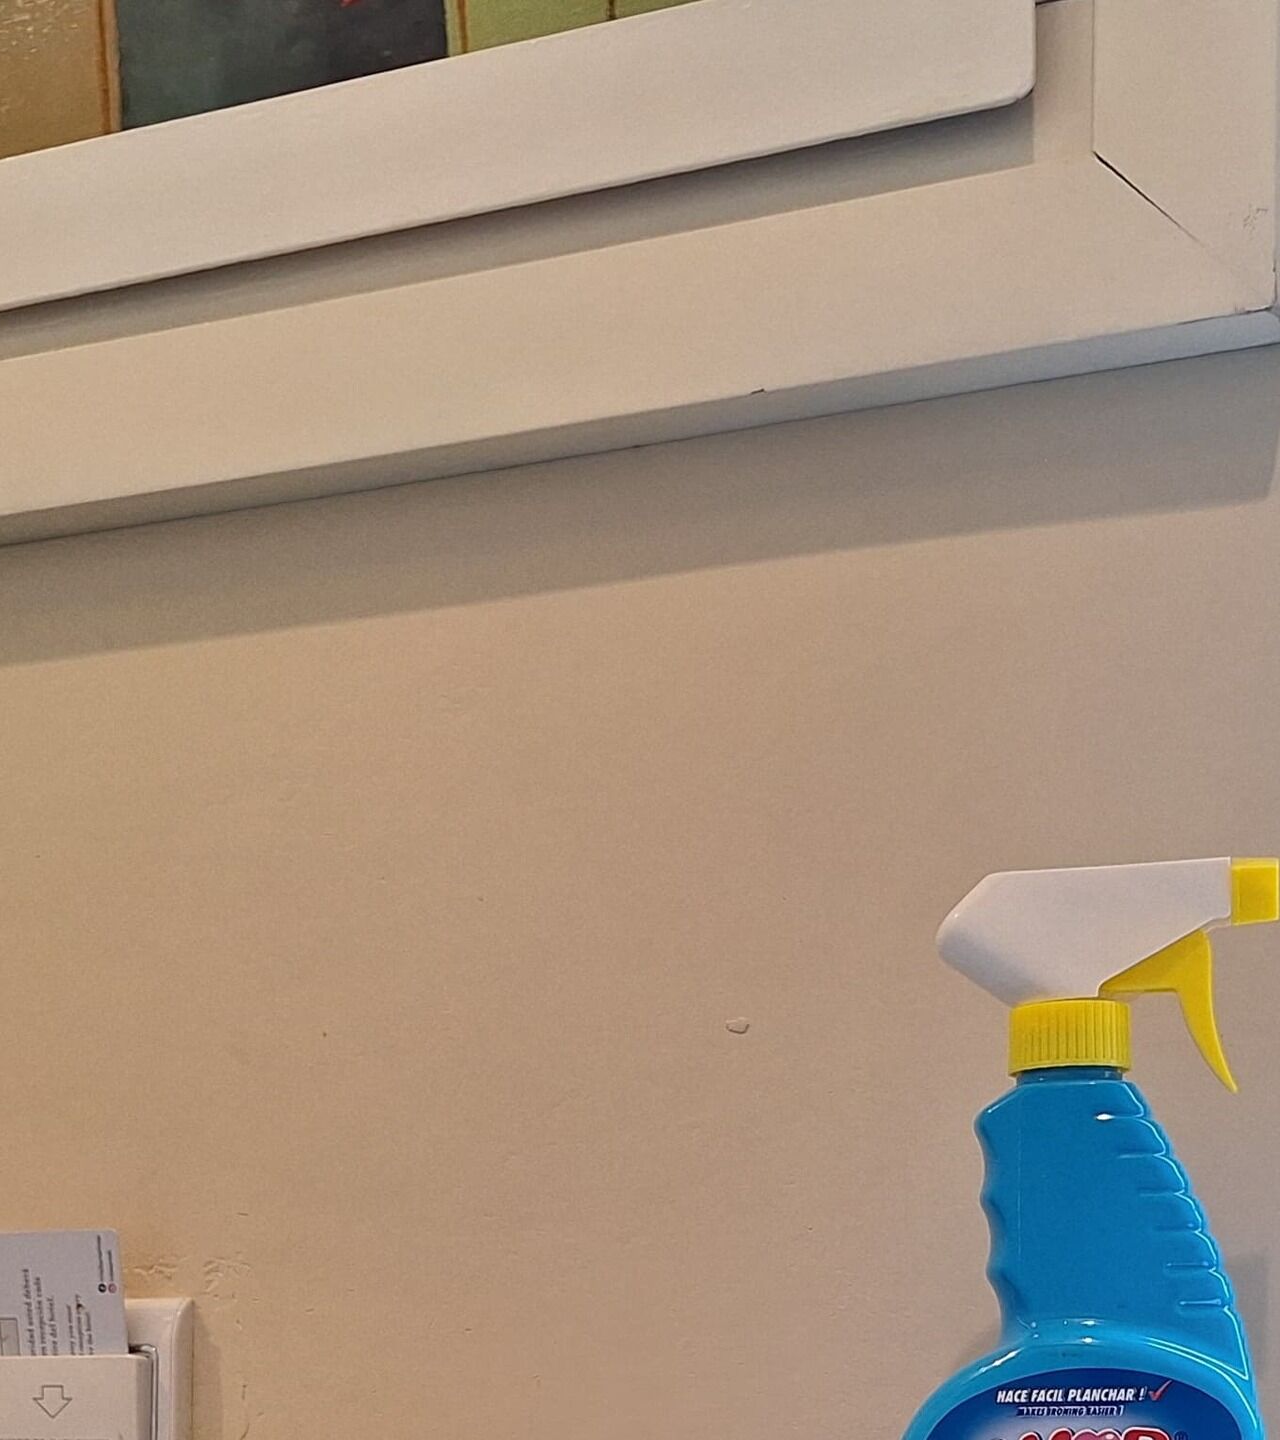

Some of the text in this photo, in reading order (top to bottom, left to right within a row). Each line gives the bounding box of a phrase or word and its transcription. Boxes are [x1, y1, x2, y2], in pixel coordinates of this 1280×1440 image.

[997, 1389, 1028, 1404] HACE
[1030, 1388, 1065, 1403] FACIL
[1068, 1386, 1136, 1402] PLANCHAR
